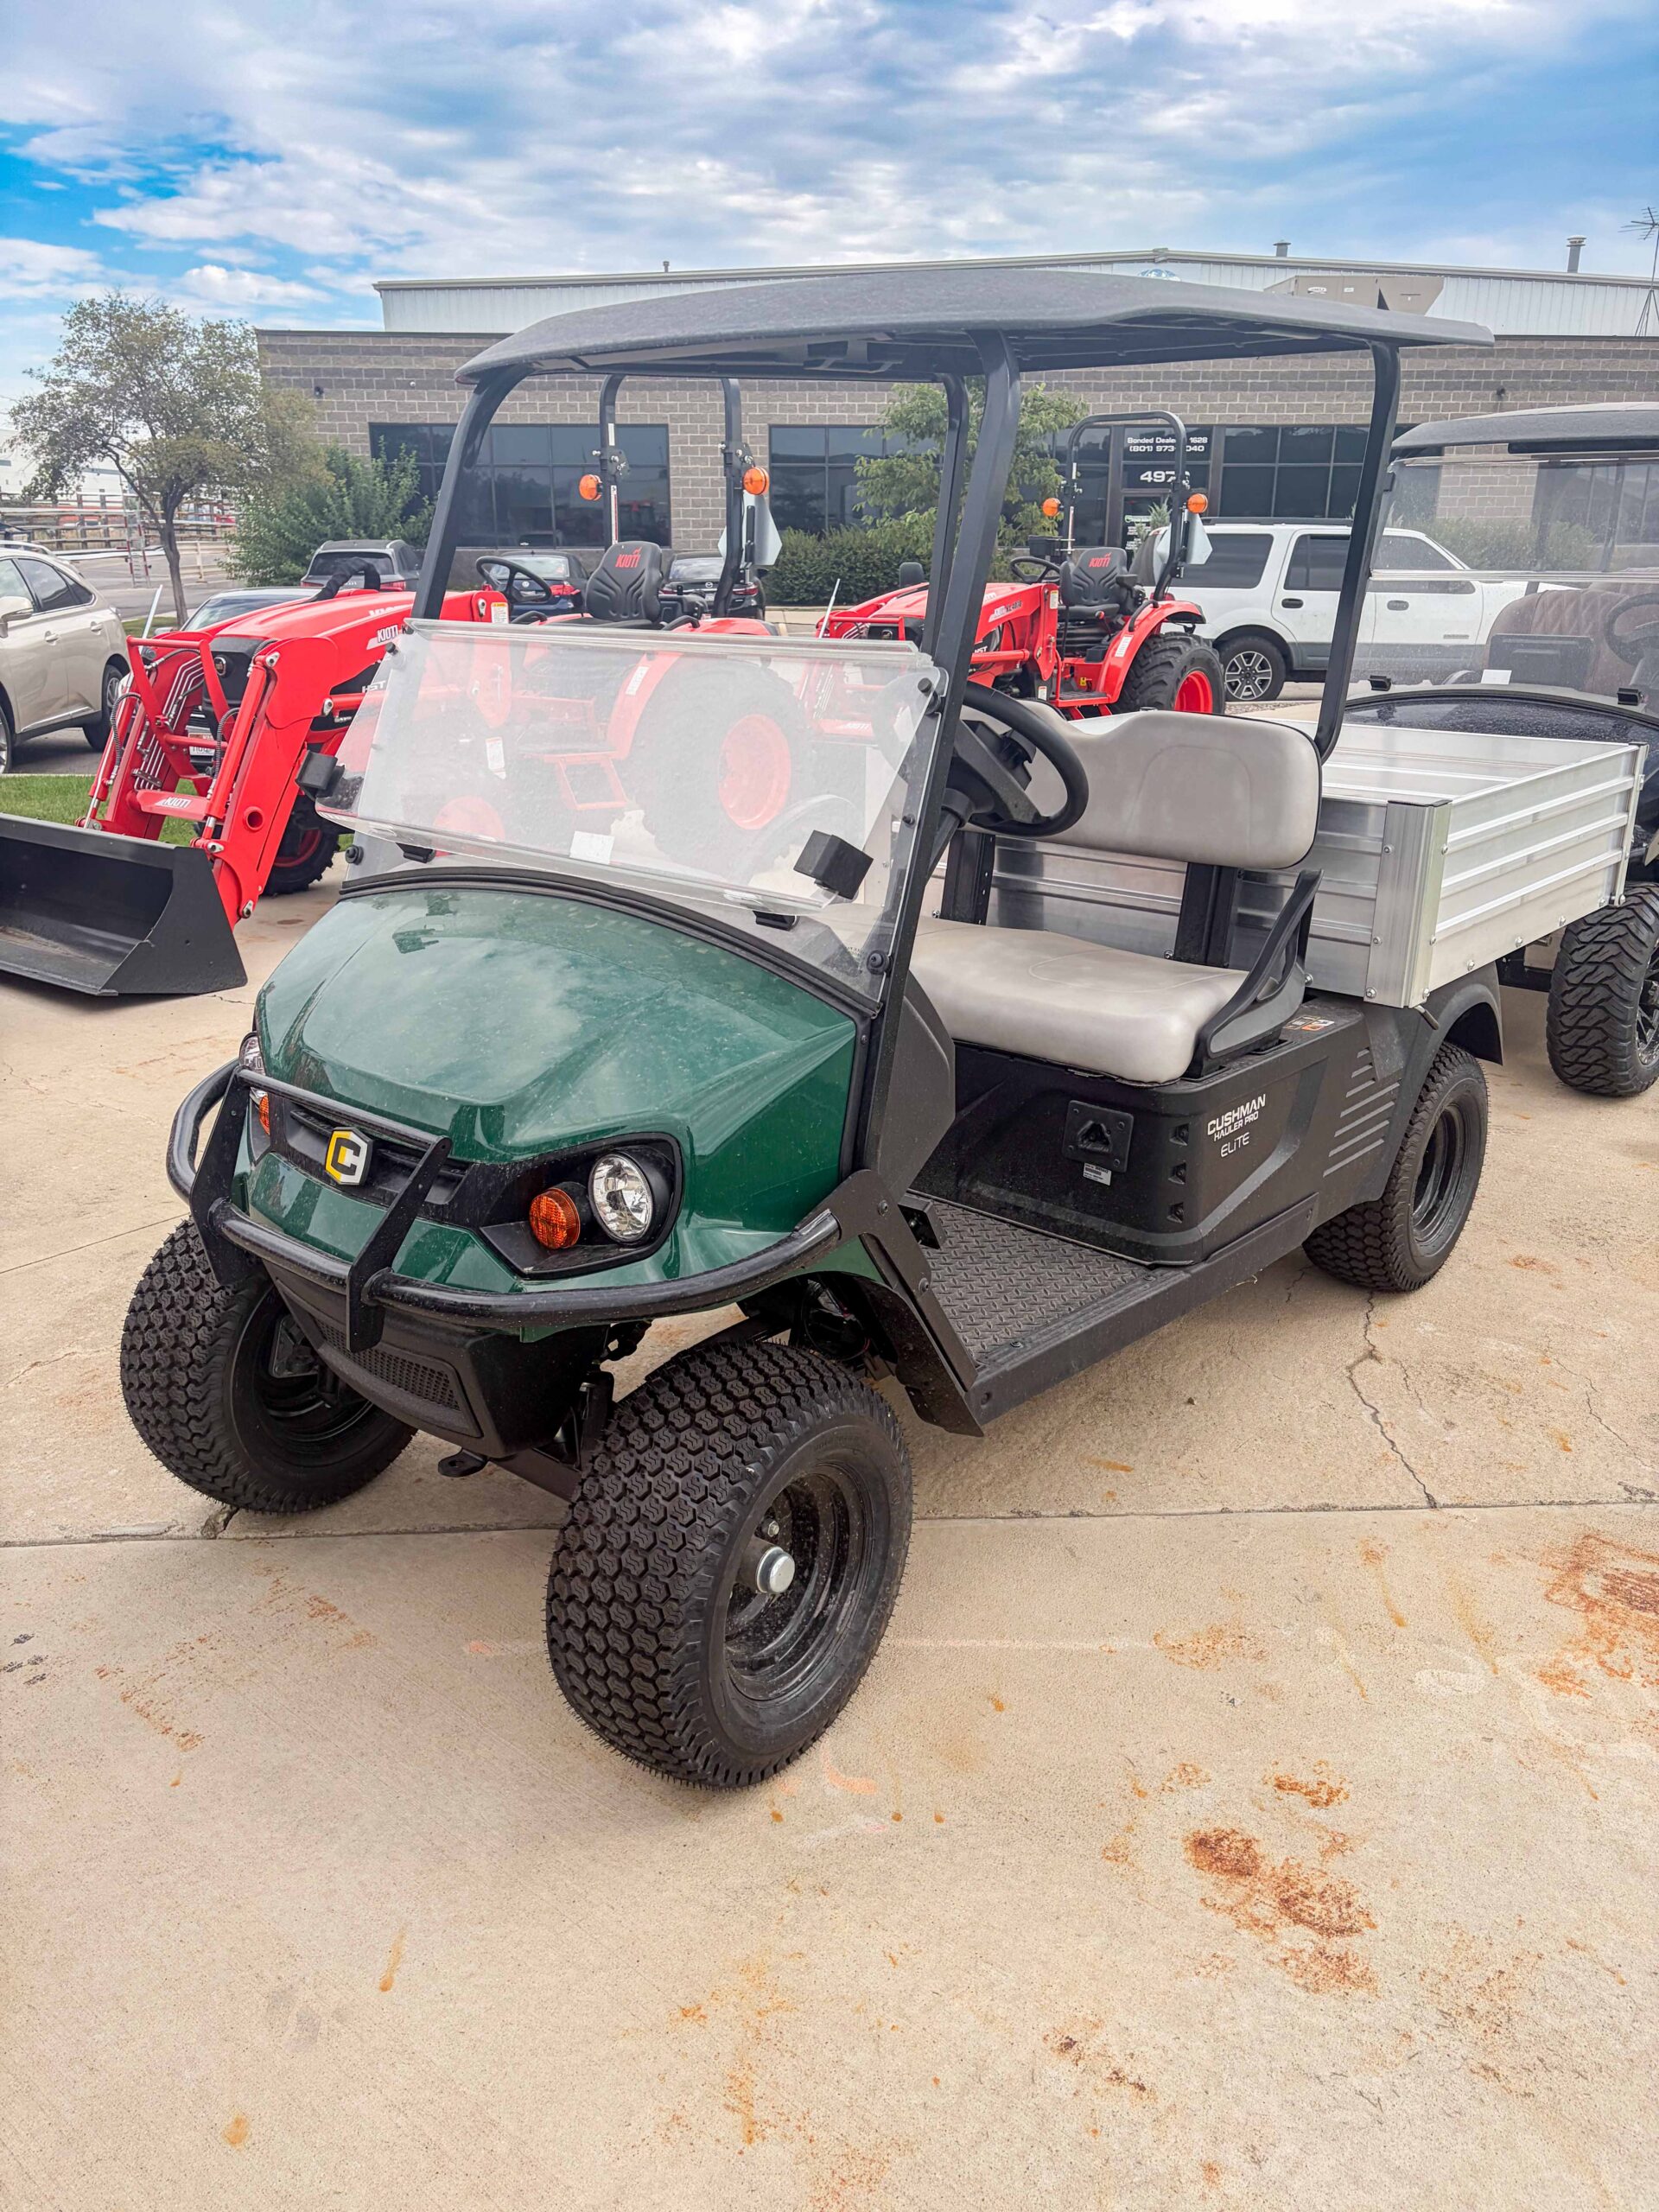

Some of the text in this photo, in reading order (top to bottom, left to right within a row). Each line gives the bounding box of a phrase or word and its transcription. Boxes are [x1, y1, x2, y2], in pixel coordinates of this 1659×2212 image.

[1140, 471, 1191, 483] 497
[377, 624, 398, 643] KIOTI
[1207, 1093, 1266, 1136] CUSHMAN
[1213, 1110, 1259, 1142] HAULER PRO
